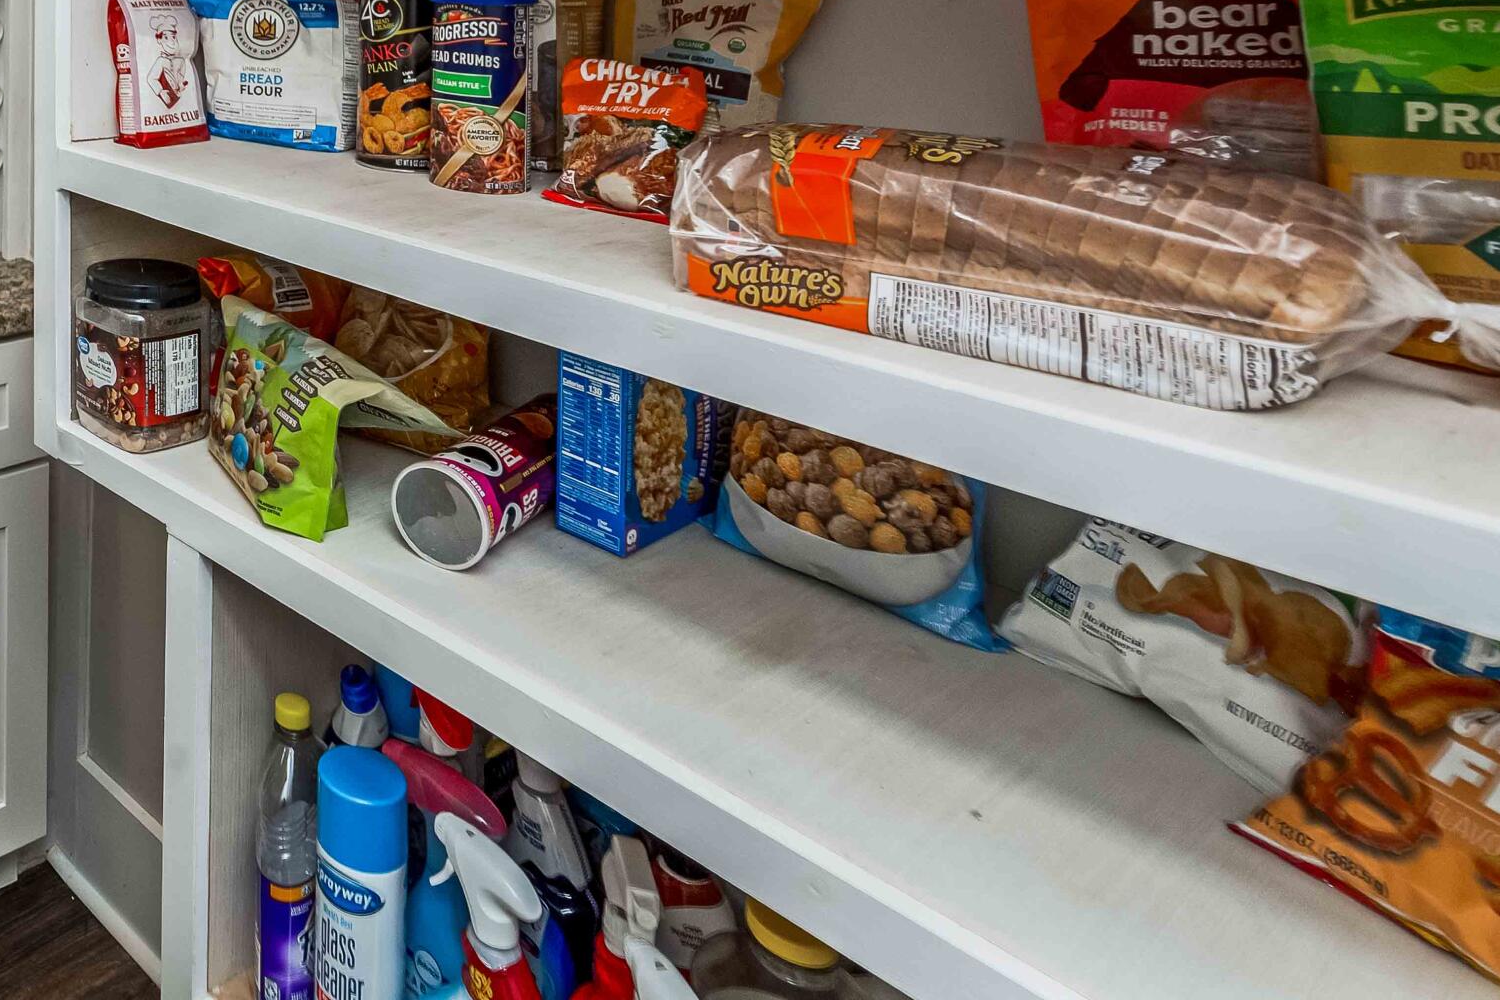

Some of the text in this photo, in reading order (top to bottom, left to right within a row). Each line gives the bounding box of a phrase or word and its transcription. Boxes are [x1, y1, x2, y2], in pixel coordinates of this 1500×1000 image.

[131, 0, 184, 8] MALT POWDER
[236, 0, 295, 26] KING ARTHUR
[672, 3, 751, 33] Red Mill
[1152, 1, 1276, 29] bear
[237, 32, 291, 55] BAKING COMPANY
[362, 41, 413, 62] ANKO
[676, 41, 705, 49] ORGANIC
[1132, 26, 1304, 56] naked
[367, 61, 399, 74] PLAIN
[453, 51, 500, 68] CRUMBS
[1137, 58, 1301, 69] WILDLY DELICIOUS GRANOLA
[240, 73, 283, 85] BREAD
[436, 77, 480, 89] ITALIAN STYLE
[240, 84, 283, 97] FLOUR
[600, 82, 660, 107] FRY
[144, 114, 179, 126] BAKERS
[577, 104, 672, 117] ORIGINAL CRUNCHY RECIPE
[1110, 107, 1169, 119] FRUIT &
[1085, 119, 1168, 132] NUT MEDLEY
[713, 258, 842, 296] Nature's
[737, 283, 809, 308] Own
[1245, 344, 1259, 390] Calories
[293, 375, 315, 395] RAISINS
[563, 378, 620, 401] Calories 130 30
[284, 390, 306, 411] ALMONDS
[276, 408, 298, 428] CASHEWS
[450, 463, 486, 498] BURSTING
[1082, 529, 1126, 565] Salt
[1055, 584, 1076, 601] GMO
[1060, 578, 1079, 592] NON
[1083, 610, 1146, 648] No Artificial
[1225, 700, 1245, 718] NET
[1272, 724, 1287, 741] OZ
[321, 917, 356, 969] glass
[317, 951, 364, 1000] cleaner
